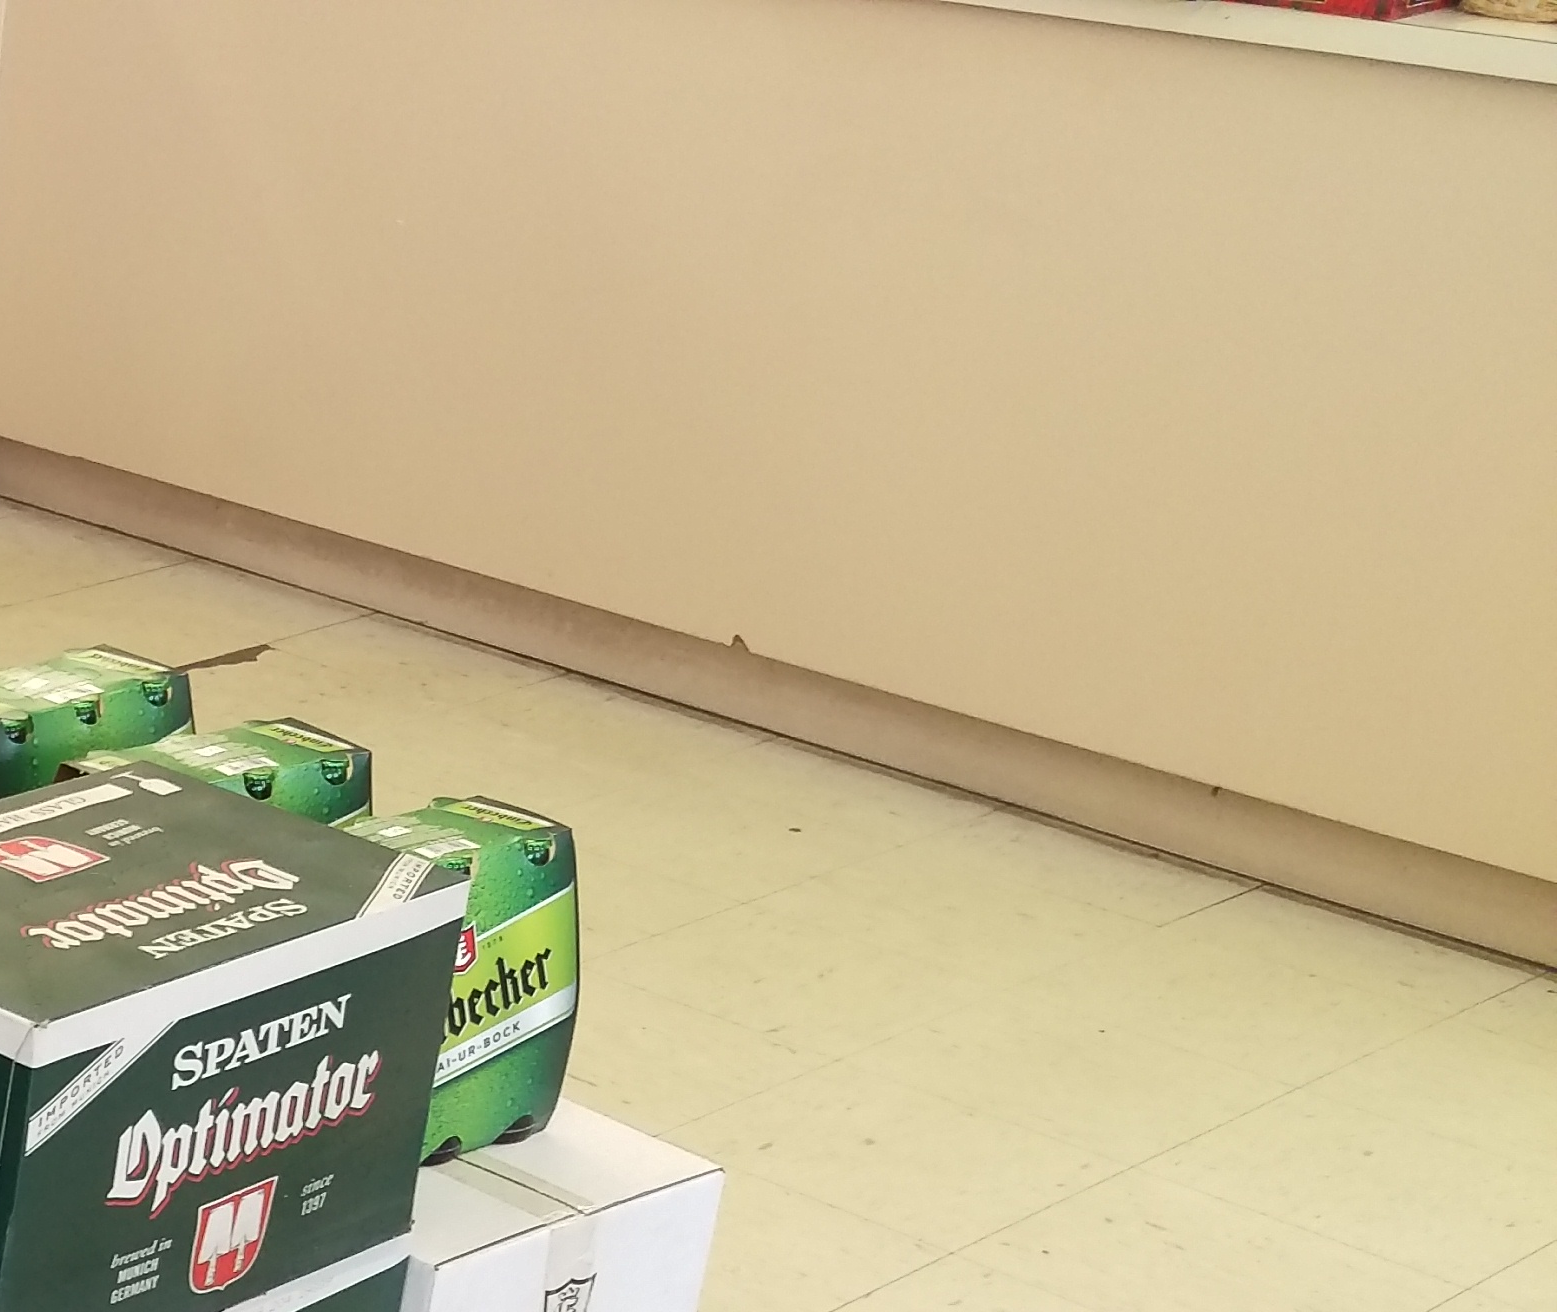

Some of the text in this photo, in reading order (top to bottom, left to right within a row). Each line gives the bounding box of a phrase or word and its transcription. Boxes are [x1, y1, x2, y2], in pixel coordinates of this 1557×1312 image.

[20, 857, 300, 951] Optimator
[138, 899, 309, 960] SPATEN
[443, 947, 552, 1044] becker
[171, 993, 352, 1092] SPATEN
[437, 1020, 522, 1076] AI-UR-BOCK
[36, 1044, 124, 1127] IMPORTED
[106, 1050, 381, 1218] Optimator
[301, 1173, 335, 1196] since
[301, 1192, 327, 1216] 1397
[109, 1239, 155, 1270] brewed
[117, 1258, 159, 1284] MUNICH
[109, 1274, 158, 1304] GERMANY
